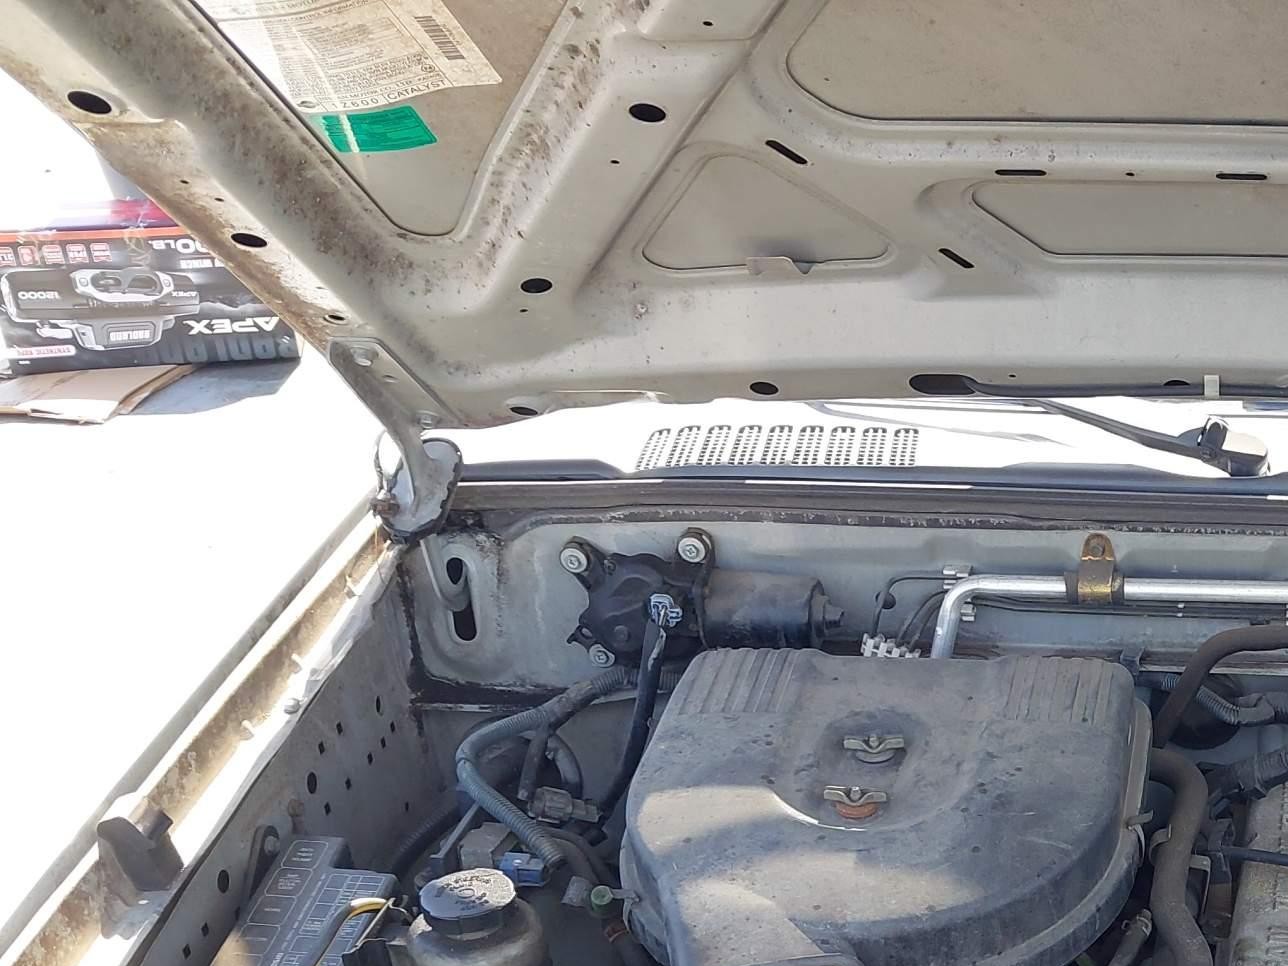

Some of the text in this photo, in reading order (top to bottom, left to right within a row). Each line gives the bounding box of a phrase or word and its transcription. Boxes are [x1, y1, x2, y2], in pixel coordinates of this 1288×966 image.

[387, 79, 448, 100] CATALYST
[17, 290, 61, 301] 12000
[171, 290, 198, 298] APEX
[183, 316, 280, 336] APEX
